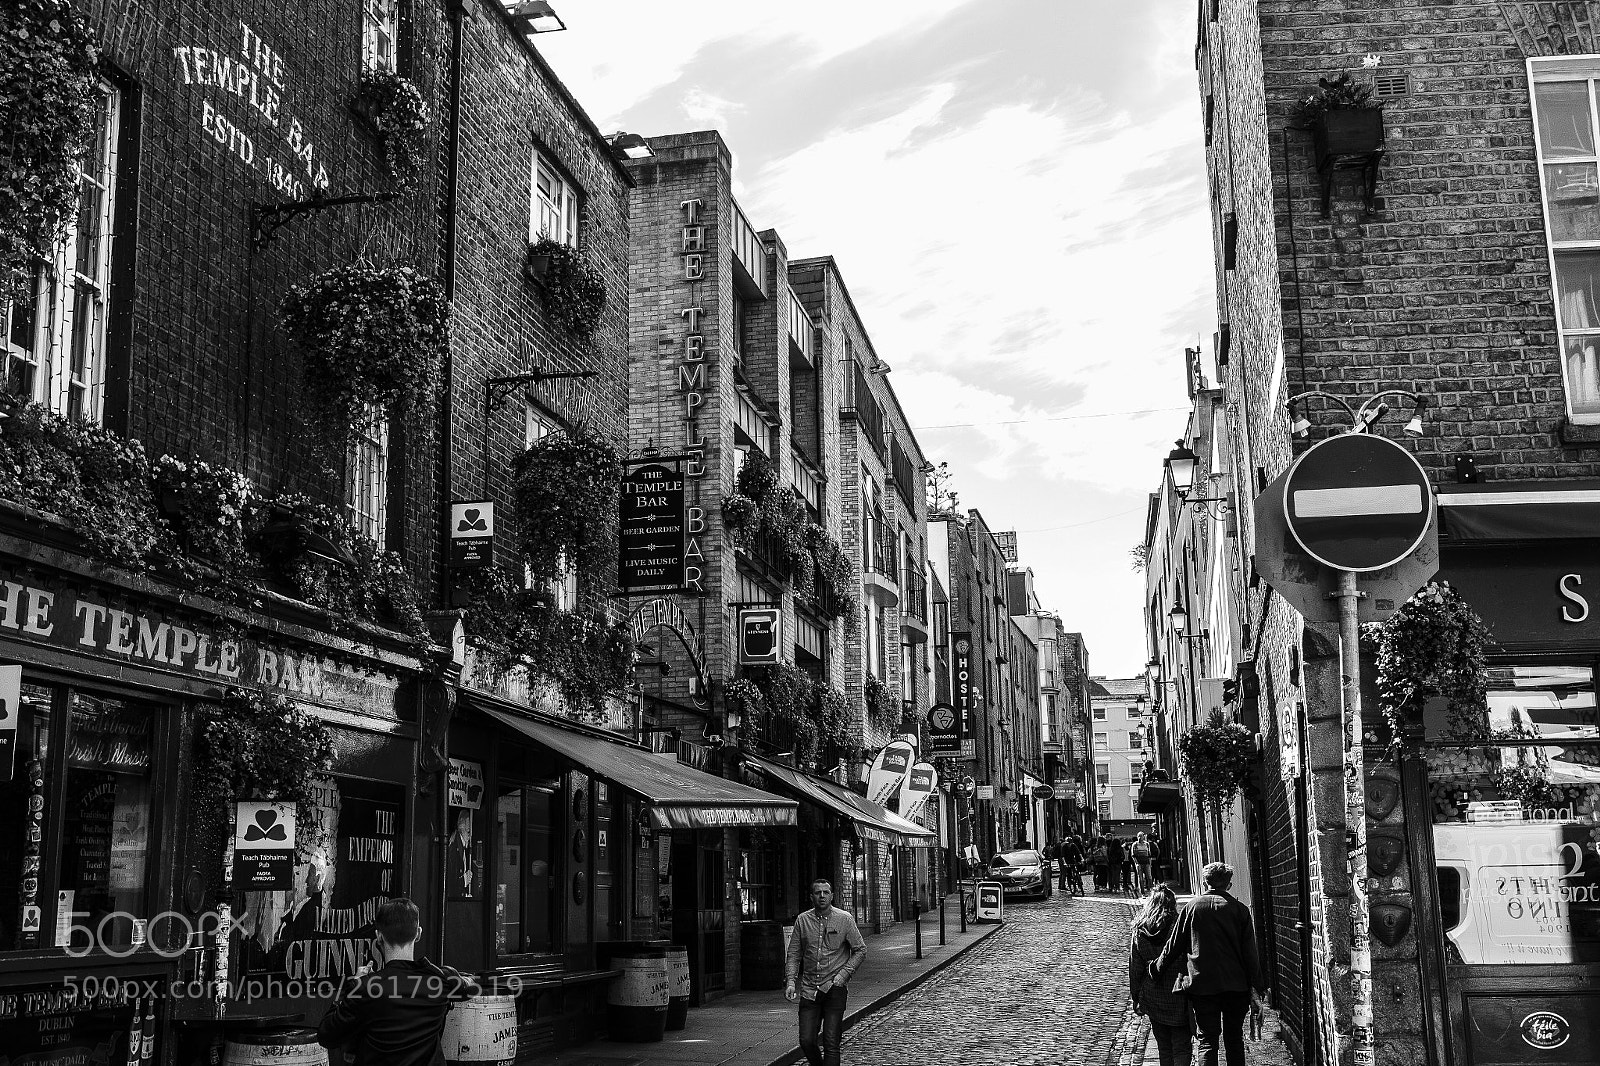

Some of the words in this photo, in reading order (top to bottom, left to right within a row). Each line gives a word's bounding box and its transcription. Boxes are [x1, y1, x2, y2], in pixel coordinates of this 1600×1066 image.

[240, 20, 284, 92] THE
[172, 46, 281, 127] TEMPLE
[286, 116, 329, 190] BAR
[680, 199, 706, 279] THE
[679, 307, 708, 476] TEMPLE
[622, 480, 682, 494] TEMPLE
[641, 471, 662, 480] THE
[636, 496, 668, 508] BAR
[623, 527, 644, 535] BEER
[645, 525, 680, 534] GARDEN
[625, 559, 646, 567] LIVE
[648, 557, 678, 566] MUSIC
[683, 507, 707, 592] BAR
[636, 568, 665, 577] DAILY
[0, 579, 55, 638] HE
[75, 600, 240, 678] TEMPLE
[651, 598, 689, 640] TEMPLE
[958, 658, 969, 733] HOSTEL
[374, 809, 395, 835] THE
[347, 836, 394, 864] EMPEROR
[258, 861, 270, 869] Pub
[381, 867, 393, 893] OF
[285, 938, 385, 979] GUINNES
[651, 981, 668, 995] JAME
[0, 993, 18, 1019] HE
[24, 989, 93, 1017] TEMPLE
[39, 1016, 76, 1033] DUBLIN
[1531, 1019, 1558, 1033] féile
[1536, 1028, 1553, 1041] bia
[65, 1055, 88, 1065] DAILY
